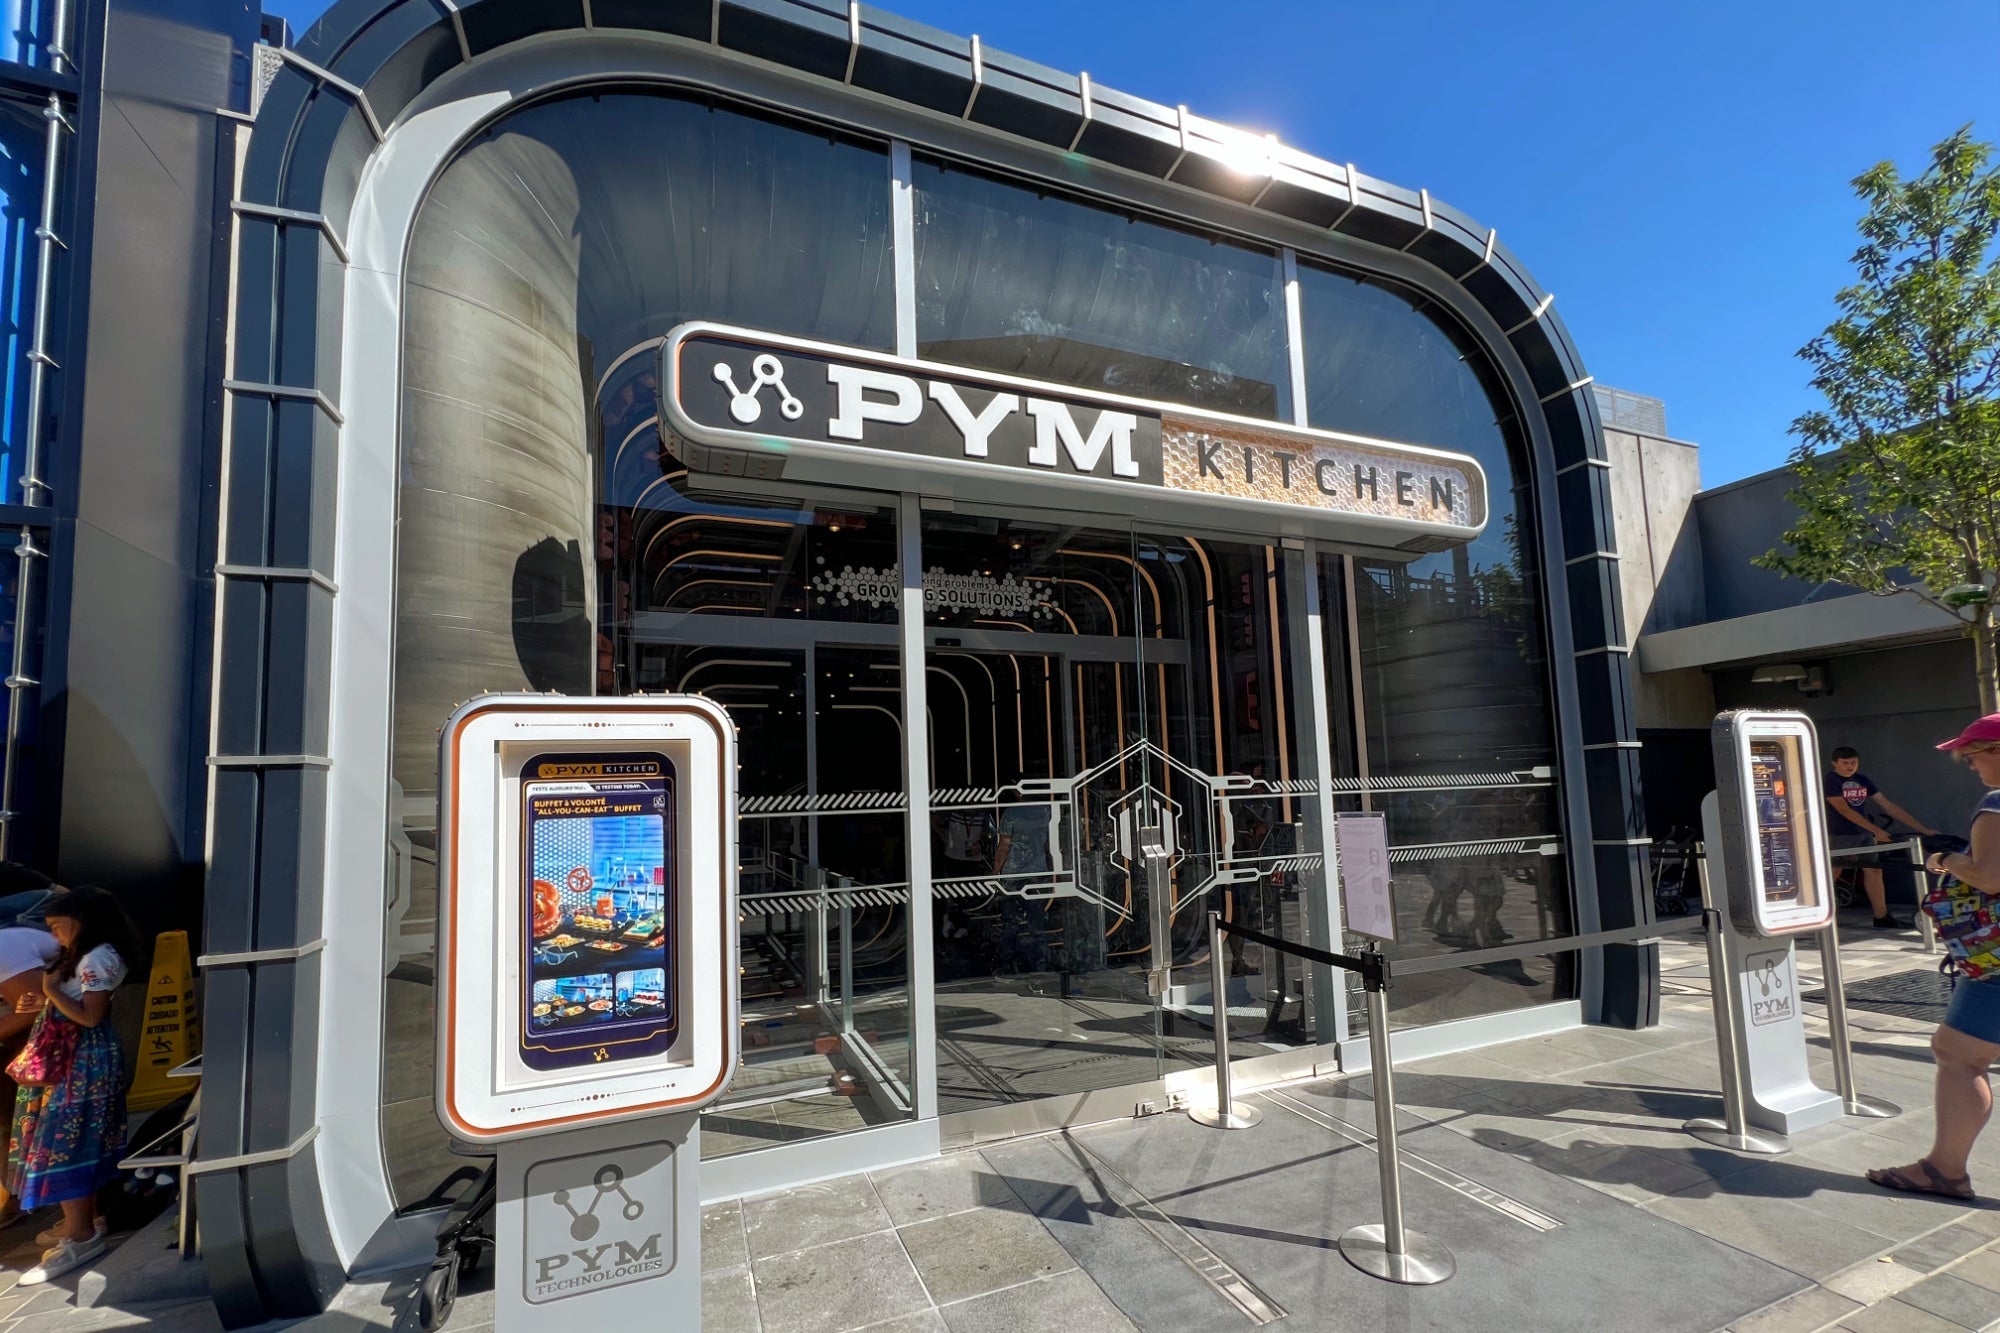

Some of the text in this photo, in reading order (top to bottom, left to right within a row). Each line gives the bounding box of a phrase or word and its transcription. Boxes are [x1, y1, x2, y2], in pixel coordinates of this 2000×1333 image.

[827, 363, 1453, 512] PYM KITCHEN
[945, 578, 990, 590] problems
[939, 589, 1023, 607] SOLUTIONS
[556, 765, 655, 775] PYM KITCHEN
[533, 800, 563, 808] BUFFET
[570, 796, 606, 807] VOLONTÉ
[614, 804, 642, 813] BUFFET
[1753, 996, 1790, 1016] PYM
[535, 1232, 662, 1284] PYM
[535, 1258, 663, 1296] TECHNOLOGIES
